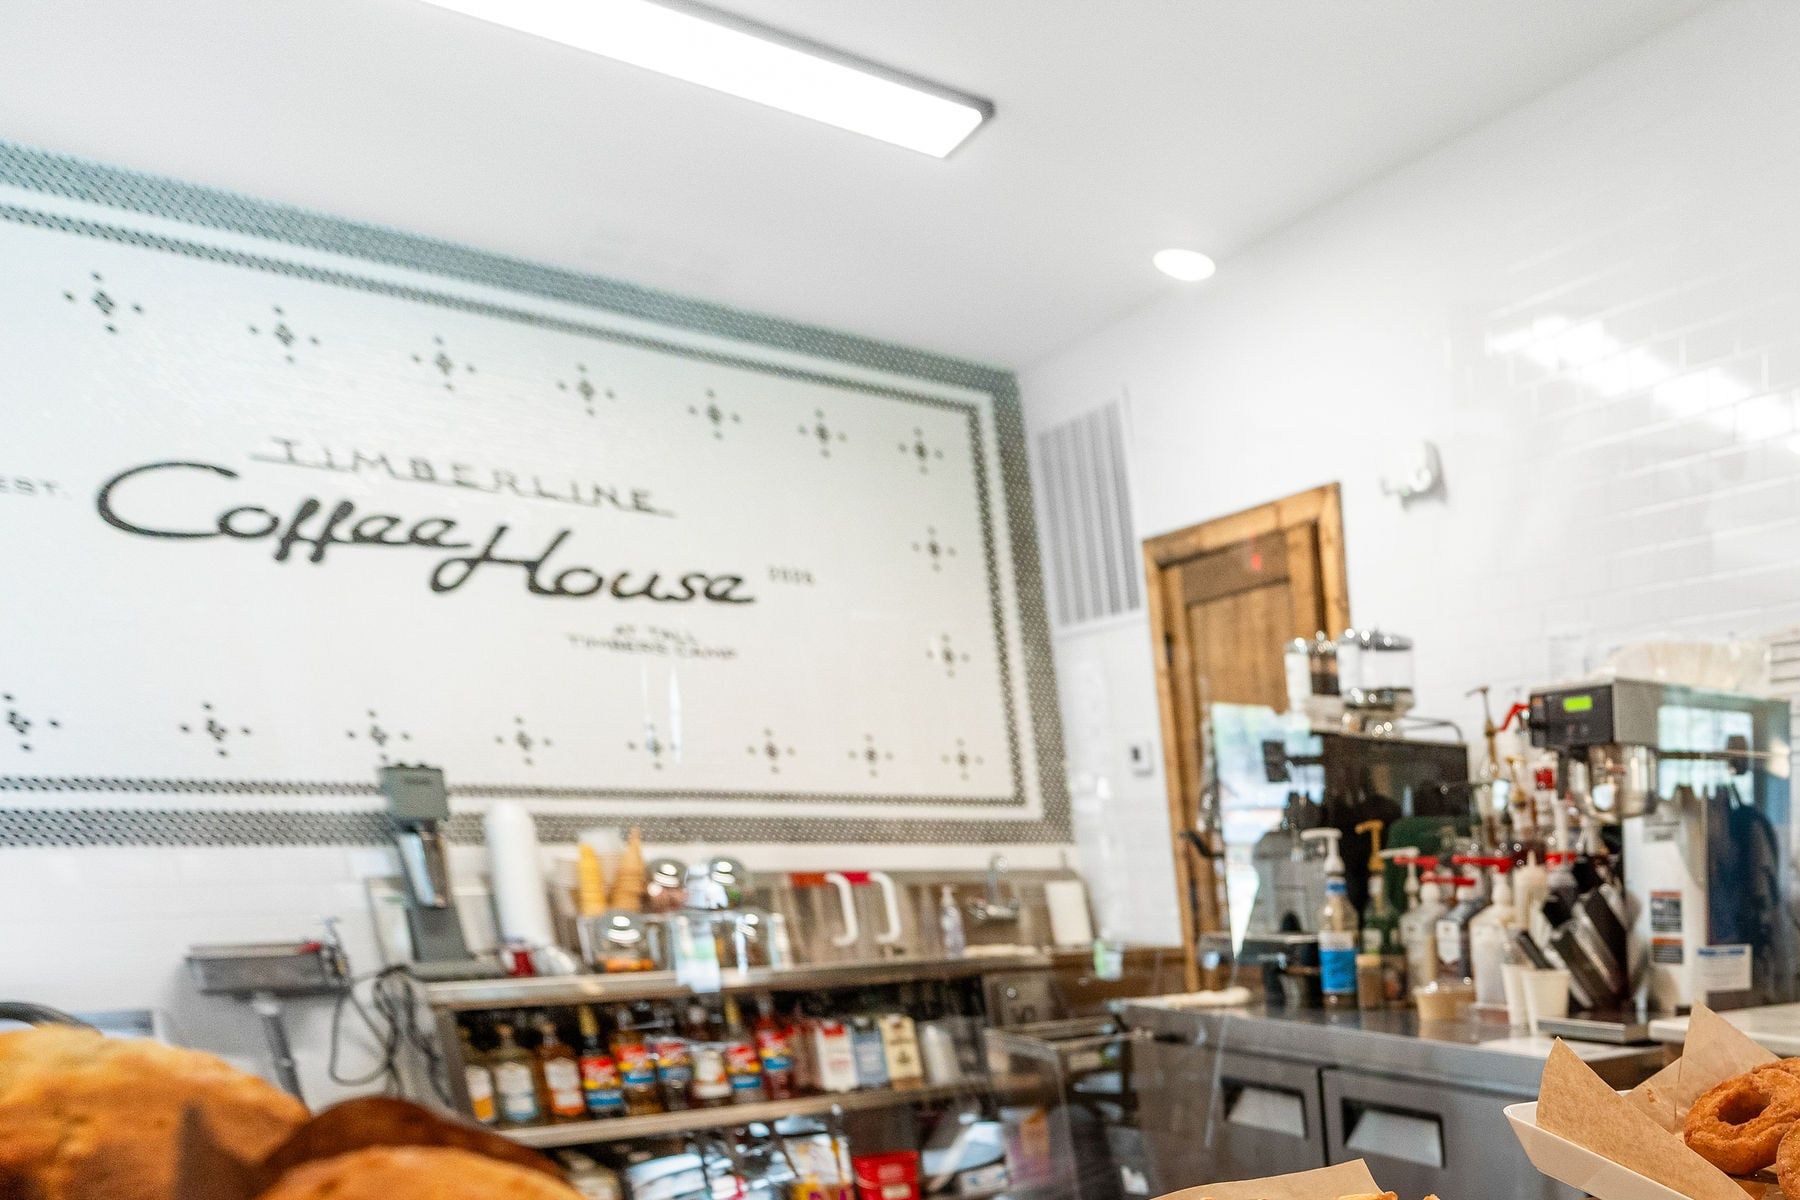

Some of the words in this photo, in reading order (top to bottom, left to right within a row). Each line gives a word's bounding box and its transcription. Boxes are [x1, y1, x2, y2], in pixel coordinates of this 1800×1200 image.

[268, 436, 662, 515] TIMBERLINE
[97, 460, 471, 562] Coffee
[429, 524, 757, 603] House
